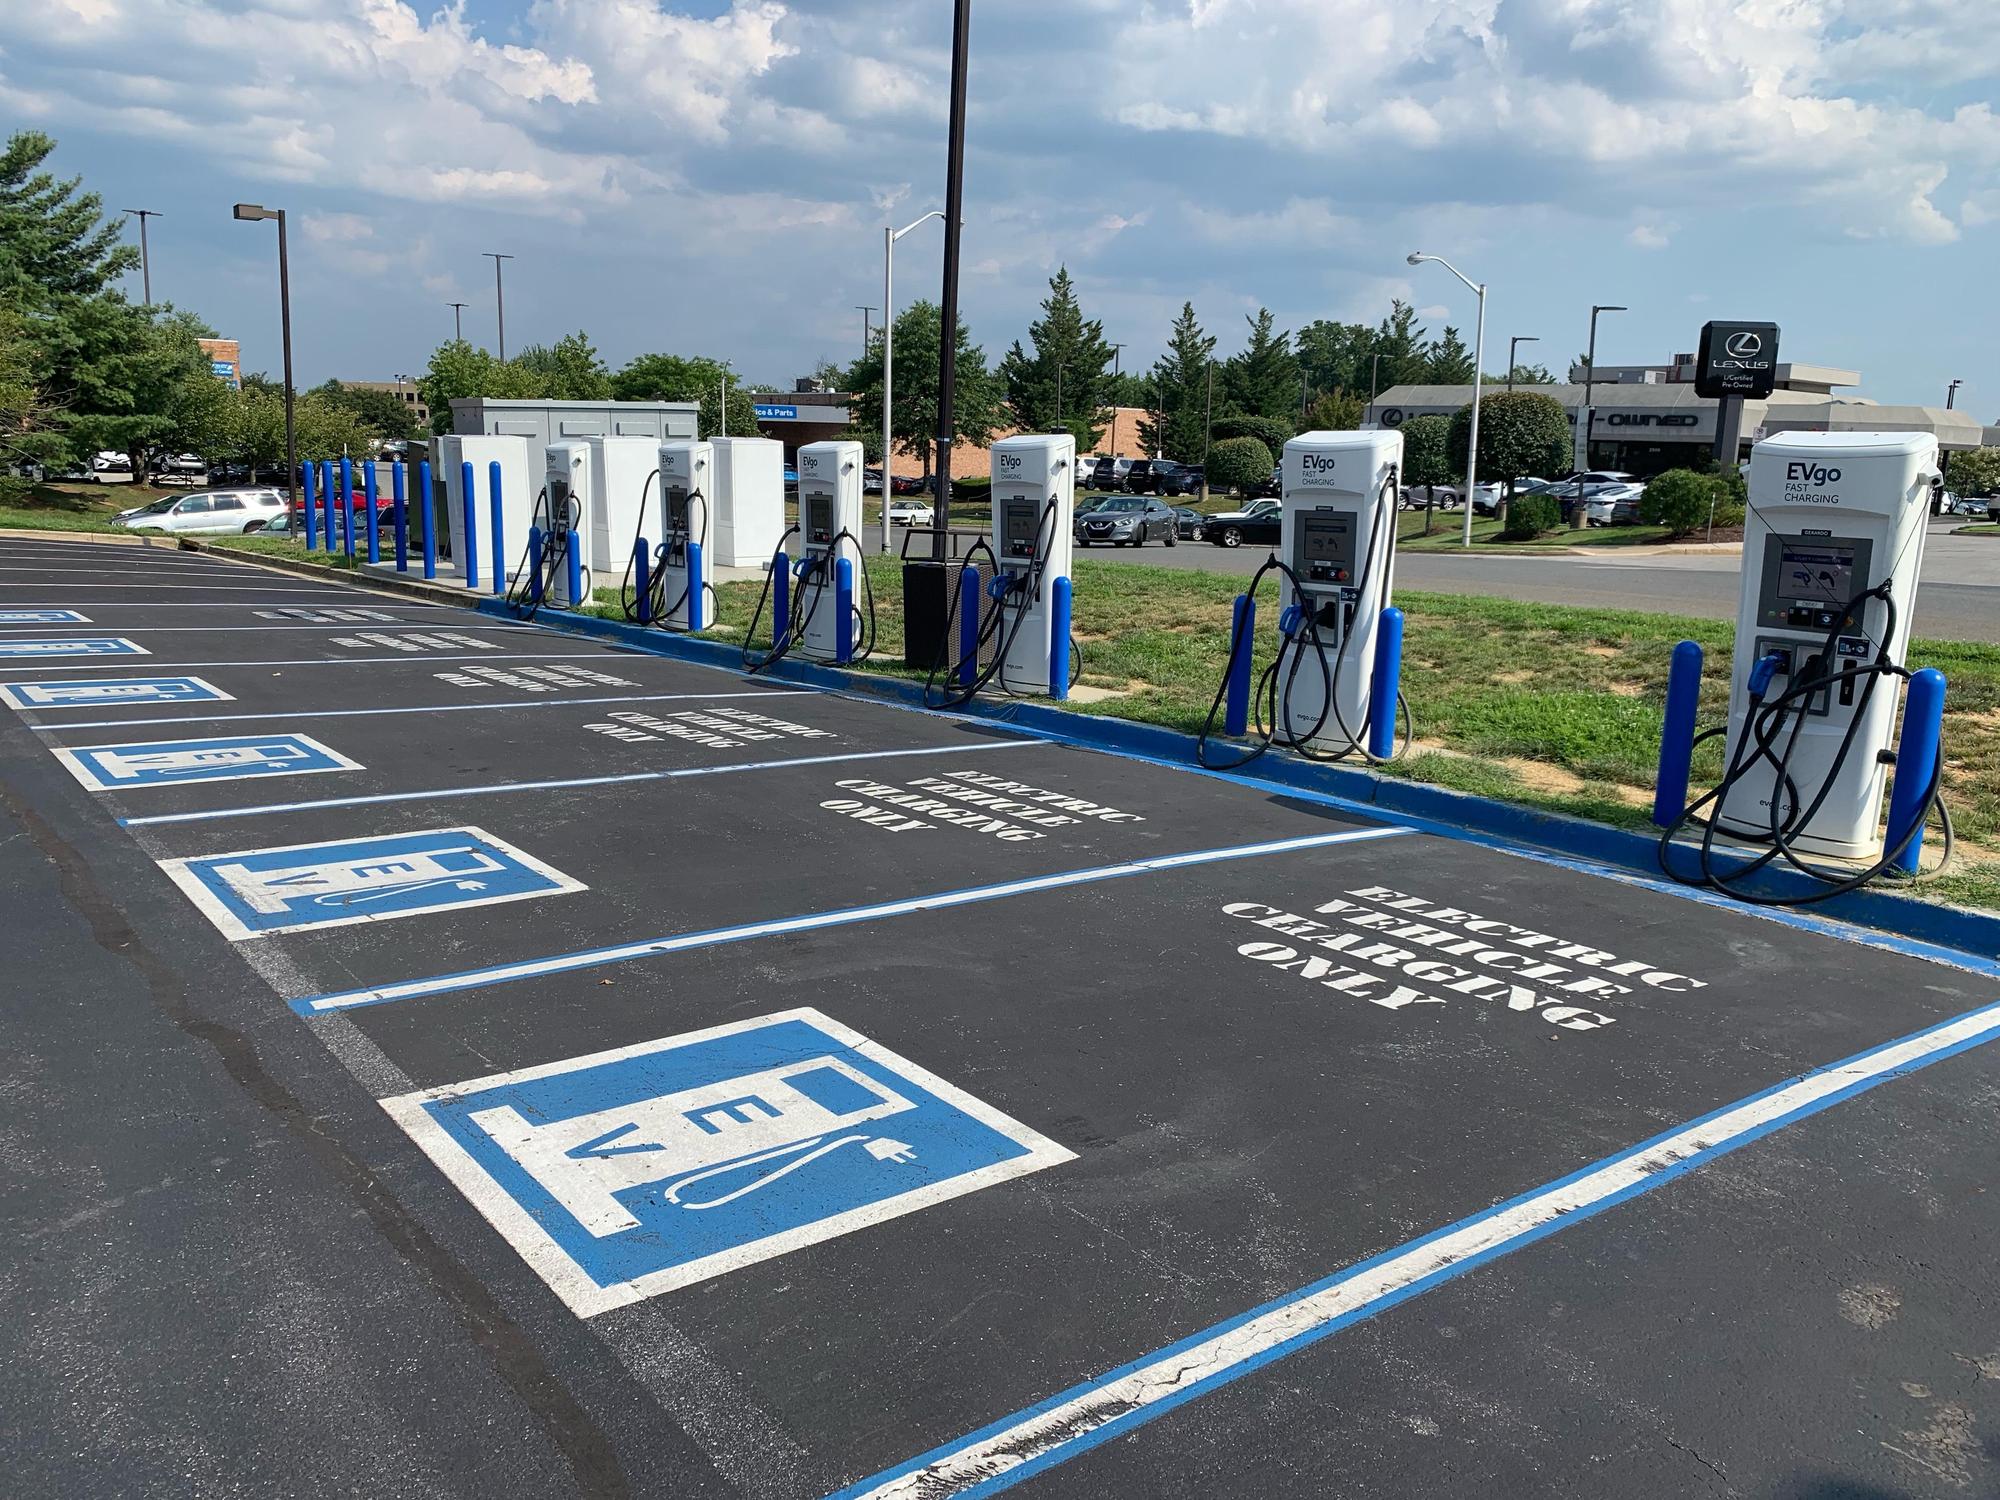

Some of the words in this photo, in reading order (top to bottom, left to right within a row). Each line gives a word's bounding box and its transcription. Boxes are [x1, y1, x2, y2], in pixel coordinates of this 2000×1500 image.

[1713, 360, 1768, 369] LEXUS
[767, 408, 773, 416] &
[803, 456, 818, 469] EVgo
[1001, 455, 1021, 469] EVgo
[1302, 455, 1335, 473] EVgo
[1787, 462, 1842, 486] EVgo
[1302, 478, 1335, 486] CHARGING
[1785, 483, 1809, 492] FAST
[1784, 493, 1839, 504] CHARGING
[582, 723, 665, 742] ONLY
[606, 711, 748, 748] CHARGING
[666, 711, 787, 741] VEHICLE
[905, 777, 1082, 827] VEHICLE
[942, 770, 1146, 822] ELECTRIC
[819, 799, 938, 832] ONLY
[834, 779, 1047, 841] CHARGING
[1315, 899, 1633, 1000] VEHICLE
[1344, 886, 1708, 992] ELECTRIC
[1221, 902, 1616, 1030] CHARGING
[1237, 942, 1447, 1010] ONLY
